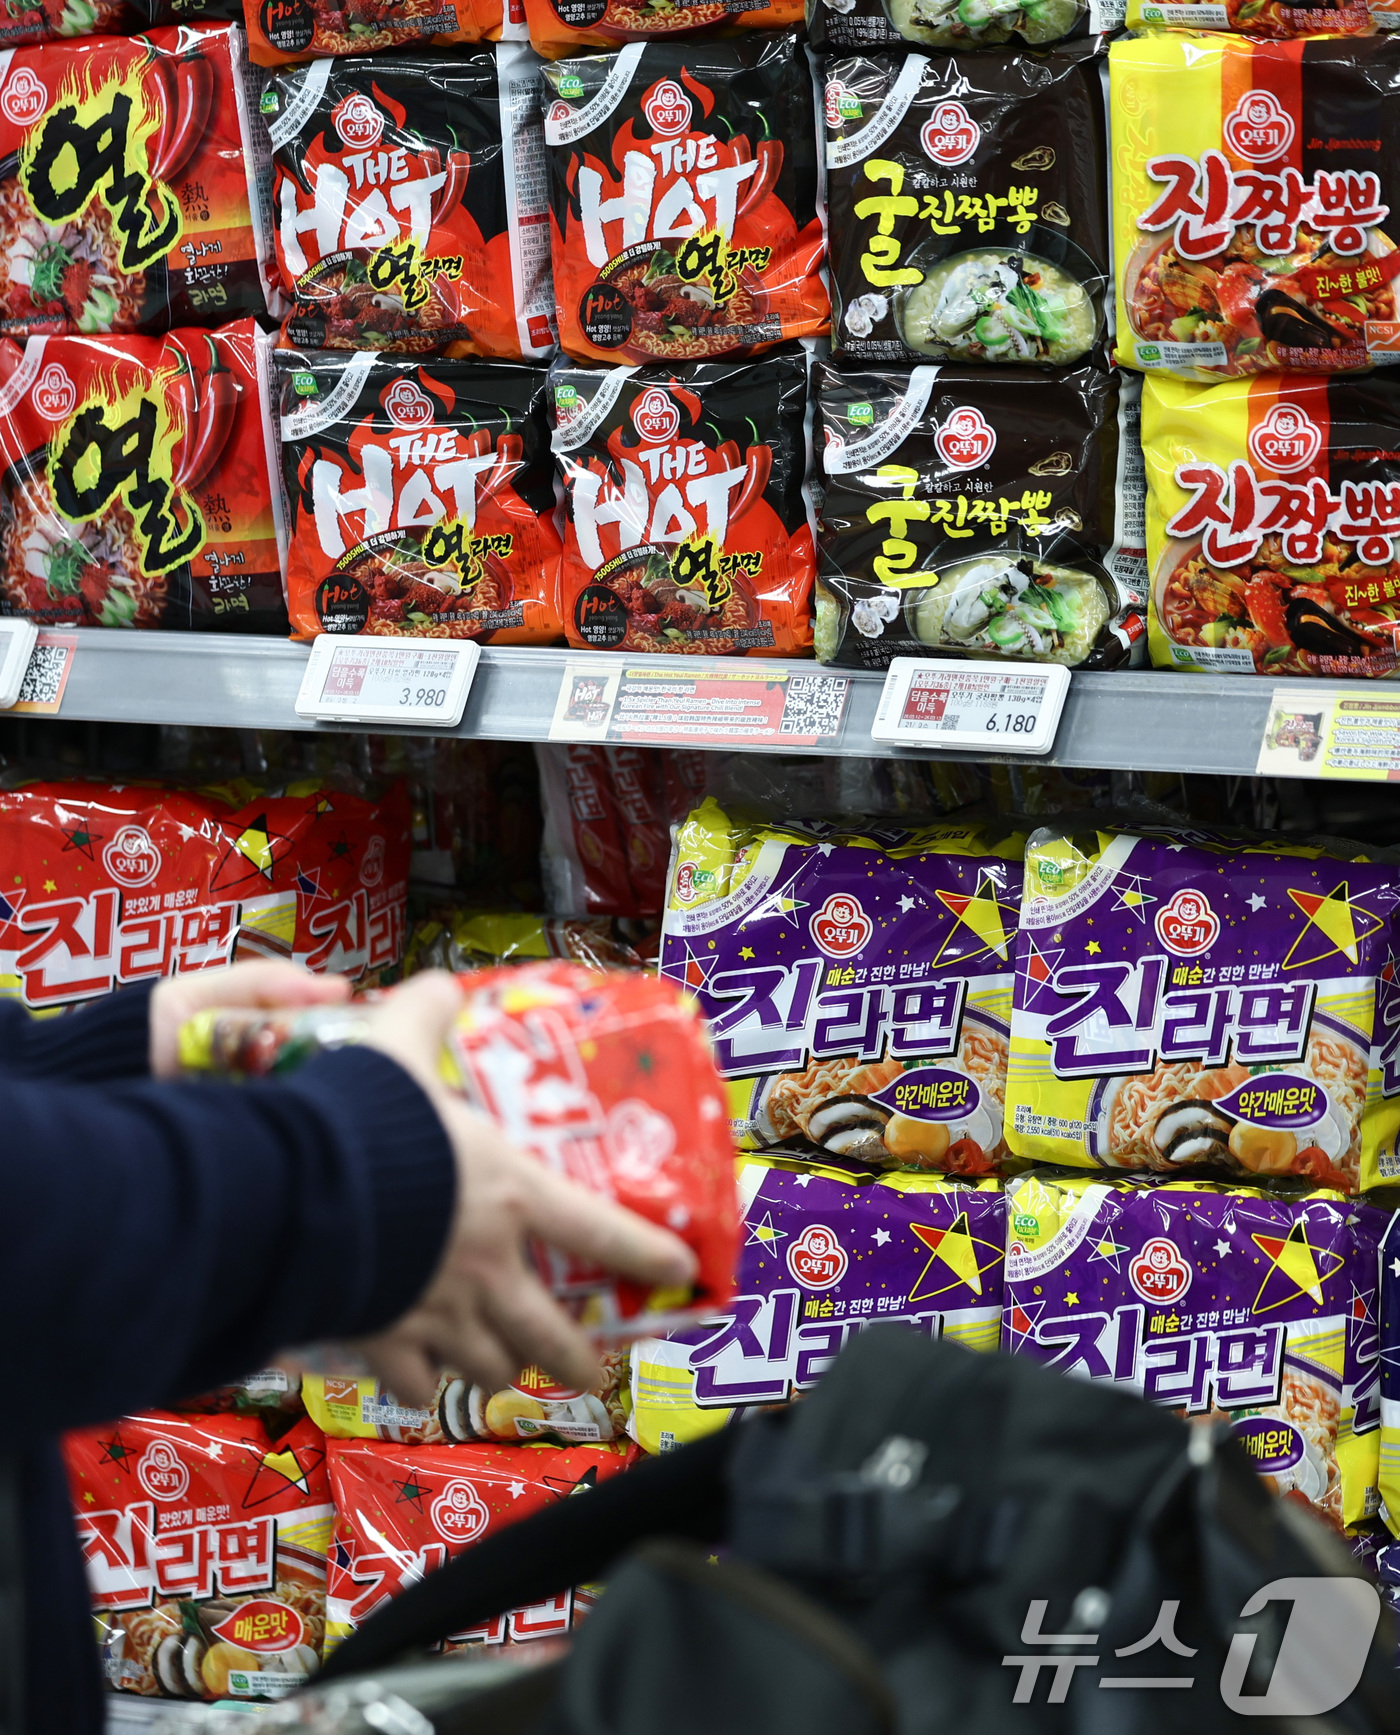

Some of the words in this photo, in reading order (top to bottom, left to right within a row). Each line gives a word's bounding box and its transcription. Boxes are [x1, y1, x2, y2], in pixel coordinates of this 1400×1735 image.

[558, 5, 570, 13] Hot
[571, 3, 586, 12] 영양!
[269, 32, 280, 40] Hot
[11, 97, 38, 112] 오뚜기
[657, 110, 682, 123] 오뚜기
[346, 124, 374, 137] 오뚜기
[1240, 128, 1279, 146] 오뚜기
[934, 135, 967, 150] 오뚜기
[1306, 137, 1324, 149] Jin
[651, 134, 719, 178] THE
[343, 149, 409, 190] THE
[25, 92, 179, 268] 열
[951, 175, 978, 188] 시원한
[182, 182, 209, 212] 熱
[1137, 150, 1390, 259] 진짬뽕
[578, 149, 761, 268] HOT
[281, 162, 449, 277] HOT
[181, 241, 222, 258] 열나게
[370, 244, 429, 310] 열
[420, 254, 465, 280] 라면
[677, 233, 737, 302] 열
[726, 247, 770, 273] 라면
[1355, 267, 1383, 290] 불맛!
[188, 283, 228, 305] 라면
[586, 293, 625, 324] Hot
[586, 325, 597, 333] Hot
[598, 324, 612, 333] 영양!
[1369, 325, 1394, 335] NCSI
[43, 394, 68, 408] 오뚜기
[397, 406, 424, 418] 오뚜기
[644, 418, 670, 431] 오뚜기
[389, 429, 461, 471] THE
[949, 441, 982, 455] 오뚜기
[1265, 440, 1304, 457] 오뚜기
[1334, 451, 1349, 461] Jin
[639, 441, 708, 486] THE
[52, 396, 204, 572] 열
[925, 481, 961, 493] 칼칼하고
[965, 480, 993, 492] 시원한
[204, 494, 230, 523] 熱
[313, 444, 499, 560] HOT
[573, 457, 749, 570] HOT
[1166, 459, 1400, 568] 진짬뽕
[204, 551, 245, 571] 열나게
[424, 523, 482, 587] 열
[471, 535, 513, 560] 라면
[674, 541, 733, 608] 열
[719, 552, 763, 578] 라면
[213, 595, 250, 614] 라면
[322, 583, 362, 614] Hot
[323, 615, 334, 623] Hot
[581, 595, 620, 625] Hot
[580, 625, 592, 633] Hot
[592, 625, 607, 634] 영양!
[332, 666, 367, 679] 담을수록
[337, 677, 354, 688] 이득
[399, 687, 446, 706] 3,980
[911, 691, 948, 703] 담을수록
[951, 691, 973, 700] 오뚜기
[917, 702, 936, 713] 이득
[986, 712, 1037, 733] 6,180
[116, 857, 148, 873] 오뚜기
[125, 898, 161, 916] 맛있게
[164, 889, 198, 909] 매운맛!
[721, 900, 733, 910] 50%
[1068, 892, 1079, 903] 50%
[823, 927, 858, 945] 오뚜기
[1168, 923, 1205, 943] 오뚜기
[15, 887, 241, 1007] 진라면
[827, 961, 867, 987] 매순간
[871, 966, 897, 981] 진한
[899, 962, 930, 979] 만남!
[1172, 961, 1216, 986] 매순간
[1219, 965, 1245, 982] 진한
[1248, 962, 1280, 979] 만남!
[708, 956, 969, 1079] 진라면
[1045, 954, 1318, 1078] 진라면
[895, 1080, 969, 1110] 약간매운맛
[1238, 1086, 1317, 1117] 약간매운맛
[1058, 1119, 1068, 1127] 600
[1046, 1244, 1056, 1254] 50%
[800, 1257, 834, 1276] 오뚜기
[1142, 1273, 1178, 1291] 오뚜기
[804, 1294, 846, 1319] 매순간
[849, 1297, 874, 1314] 진한
[877, 1294, 906, 1312] 만남!
[1150, 1311, 1194, 1335] 매순간
[1196, 1314, 1219, 1328] 진한
[1222, 1308, 1250, 1326] 만남!
[325, 1380, 346, 1389] NCSI
[150, 1471, 179, 1487] 오뚜기
[160, 1511, 193, 1529] 맛있게
[196, 1504, 230, 1523] 매운맛!
[443, 1511, 477, 1530] 오뚜기
[73, 1500, 279, 1613] 진라면
[233, 1613, 288, 1641] 매운맛
